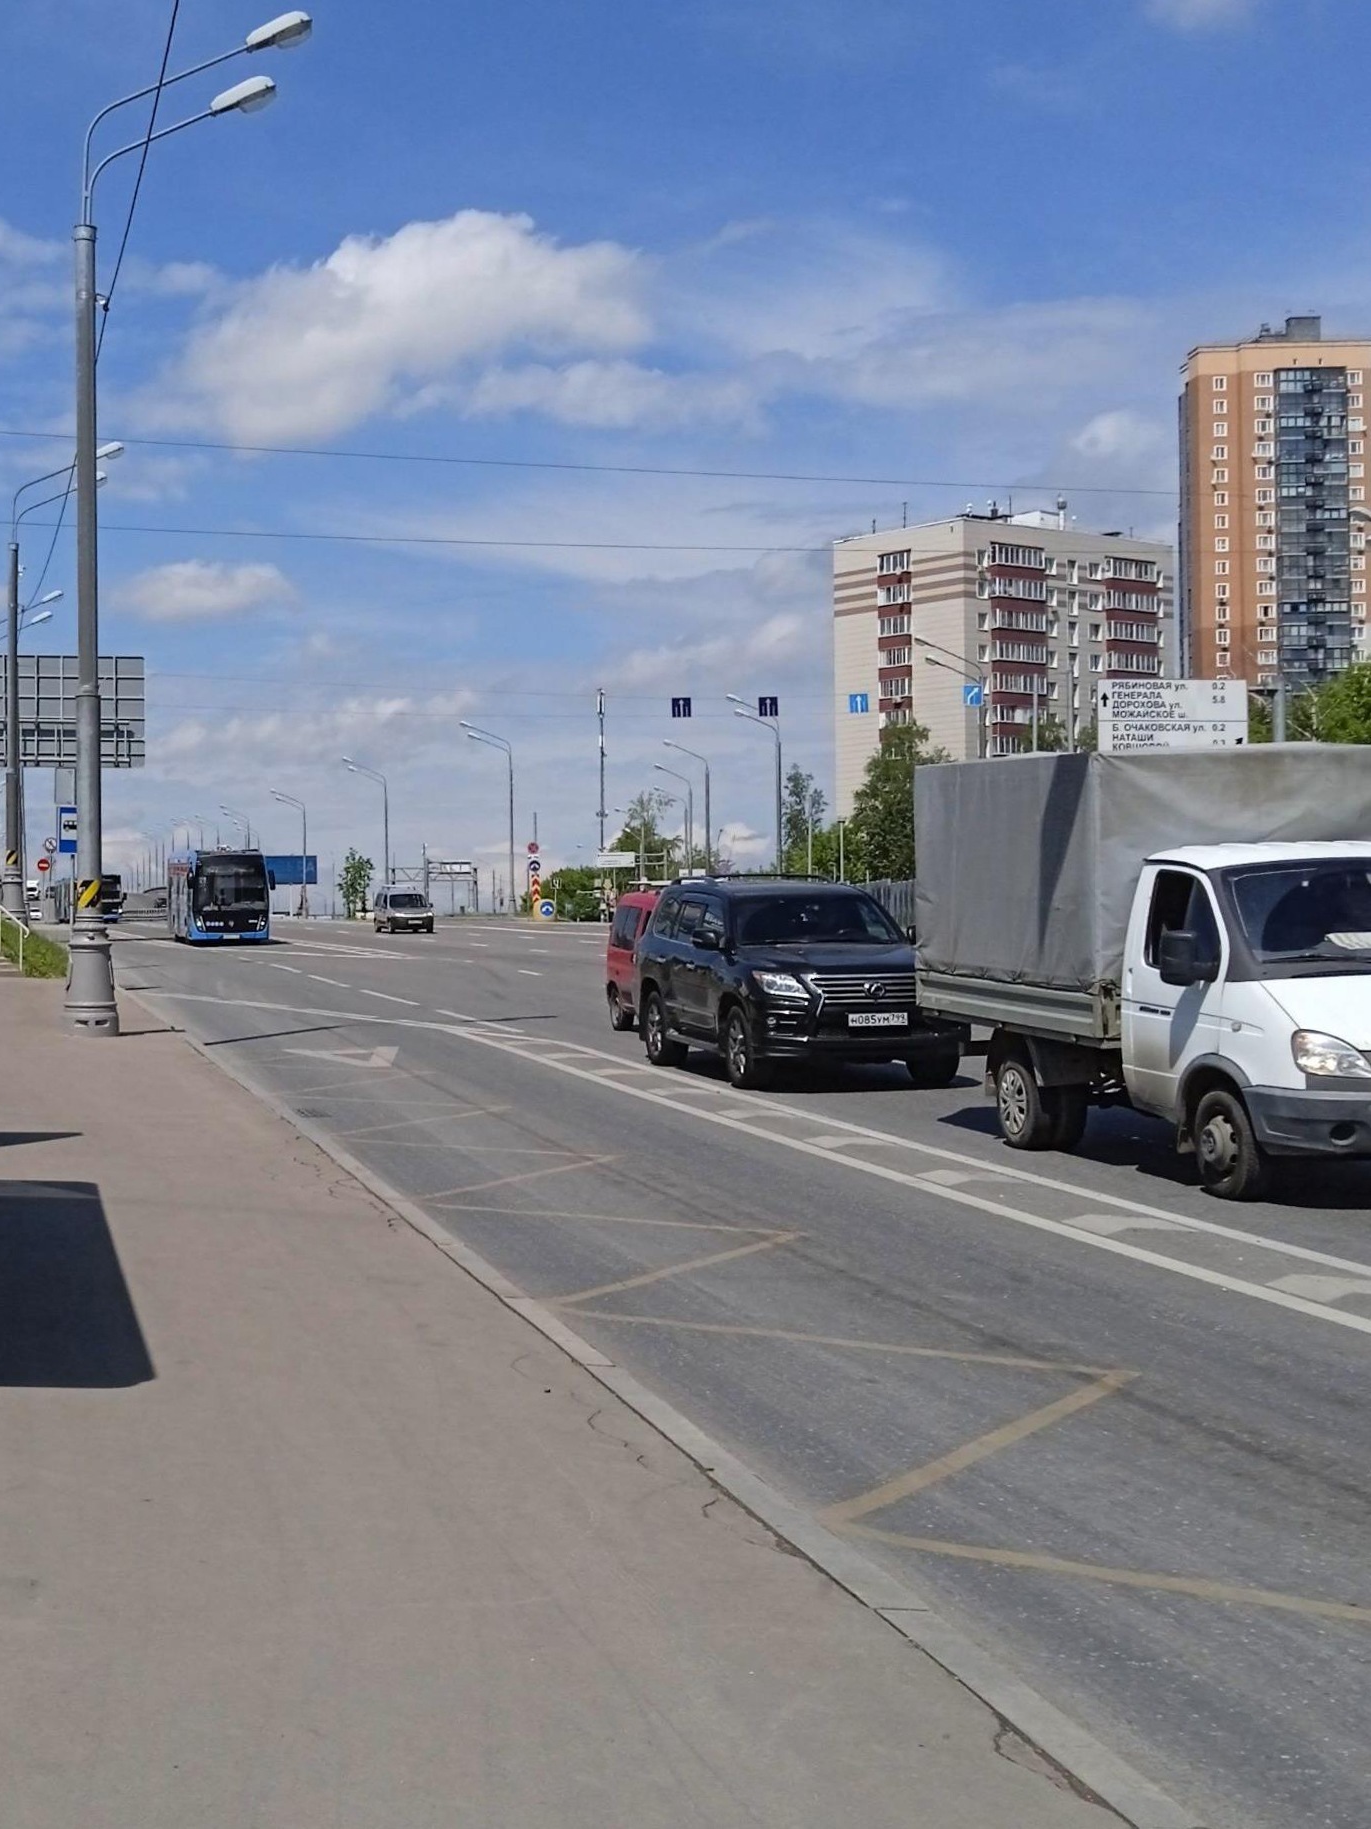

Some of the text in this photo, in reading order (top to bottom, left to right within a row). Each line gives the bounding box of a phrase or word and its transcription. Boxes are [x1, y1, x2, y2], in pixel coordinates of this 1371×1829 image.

[1112, 682, 1225, 692] РЯБИНОВАЯ ул. 0.2
[1112, 691, 1162, 699] ГЕНЕРАЛА
[1212, 695, 1226, 704] 5.8
[1113, 700, 1182, 711] ДОРОХОВА ул.
[1124, 723, 1190, 731] ОЧАКОВСКАЯ
[1193, 725, 1206, 733] ул.
[1212, 723, 1226, 731] 0.2
[1113, 733, 1154, 741] НАТАШИ
